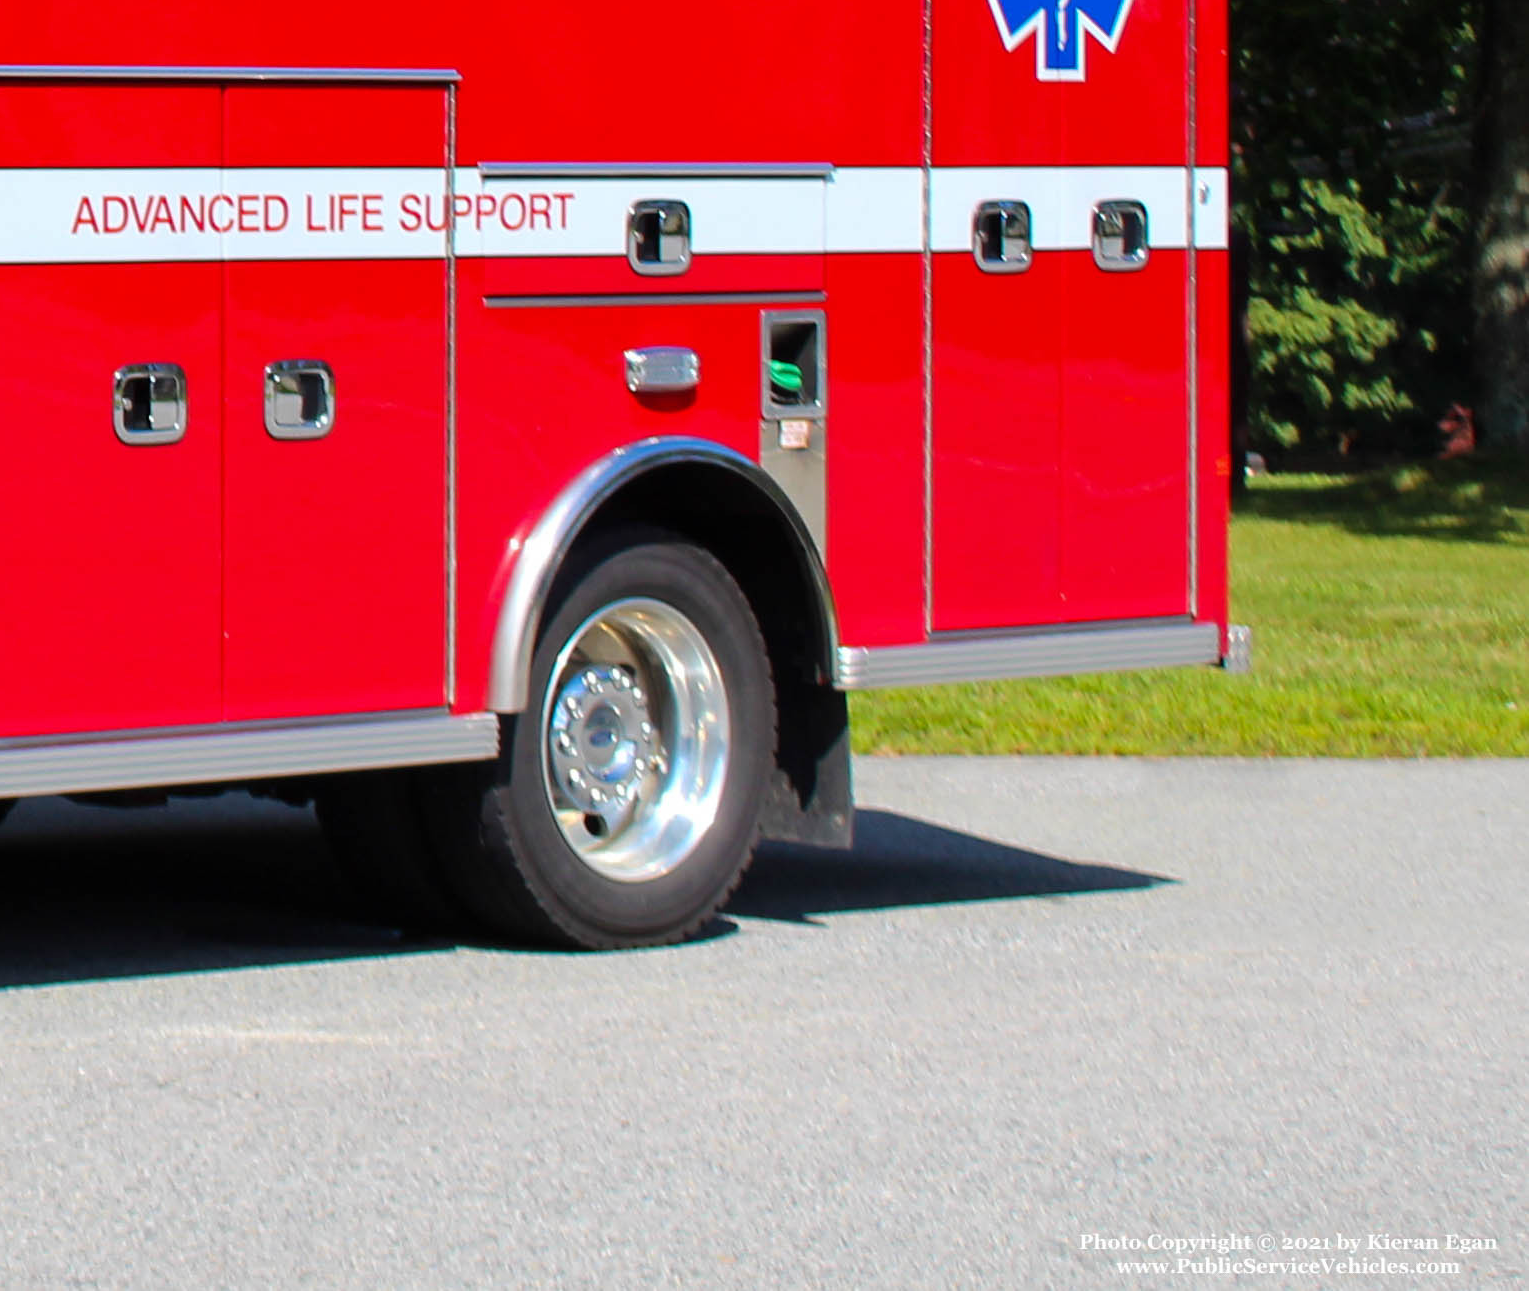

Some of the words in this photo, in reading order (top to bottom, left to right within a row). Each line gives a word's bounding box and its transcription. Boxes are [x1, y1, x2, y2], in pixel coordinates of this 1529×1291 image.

[71, 195, 289, 234] ADVANCED
[306, 194, 384, 232] LIFE
[399, 192, 575, 233] SUPPORT
